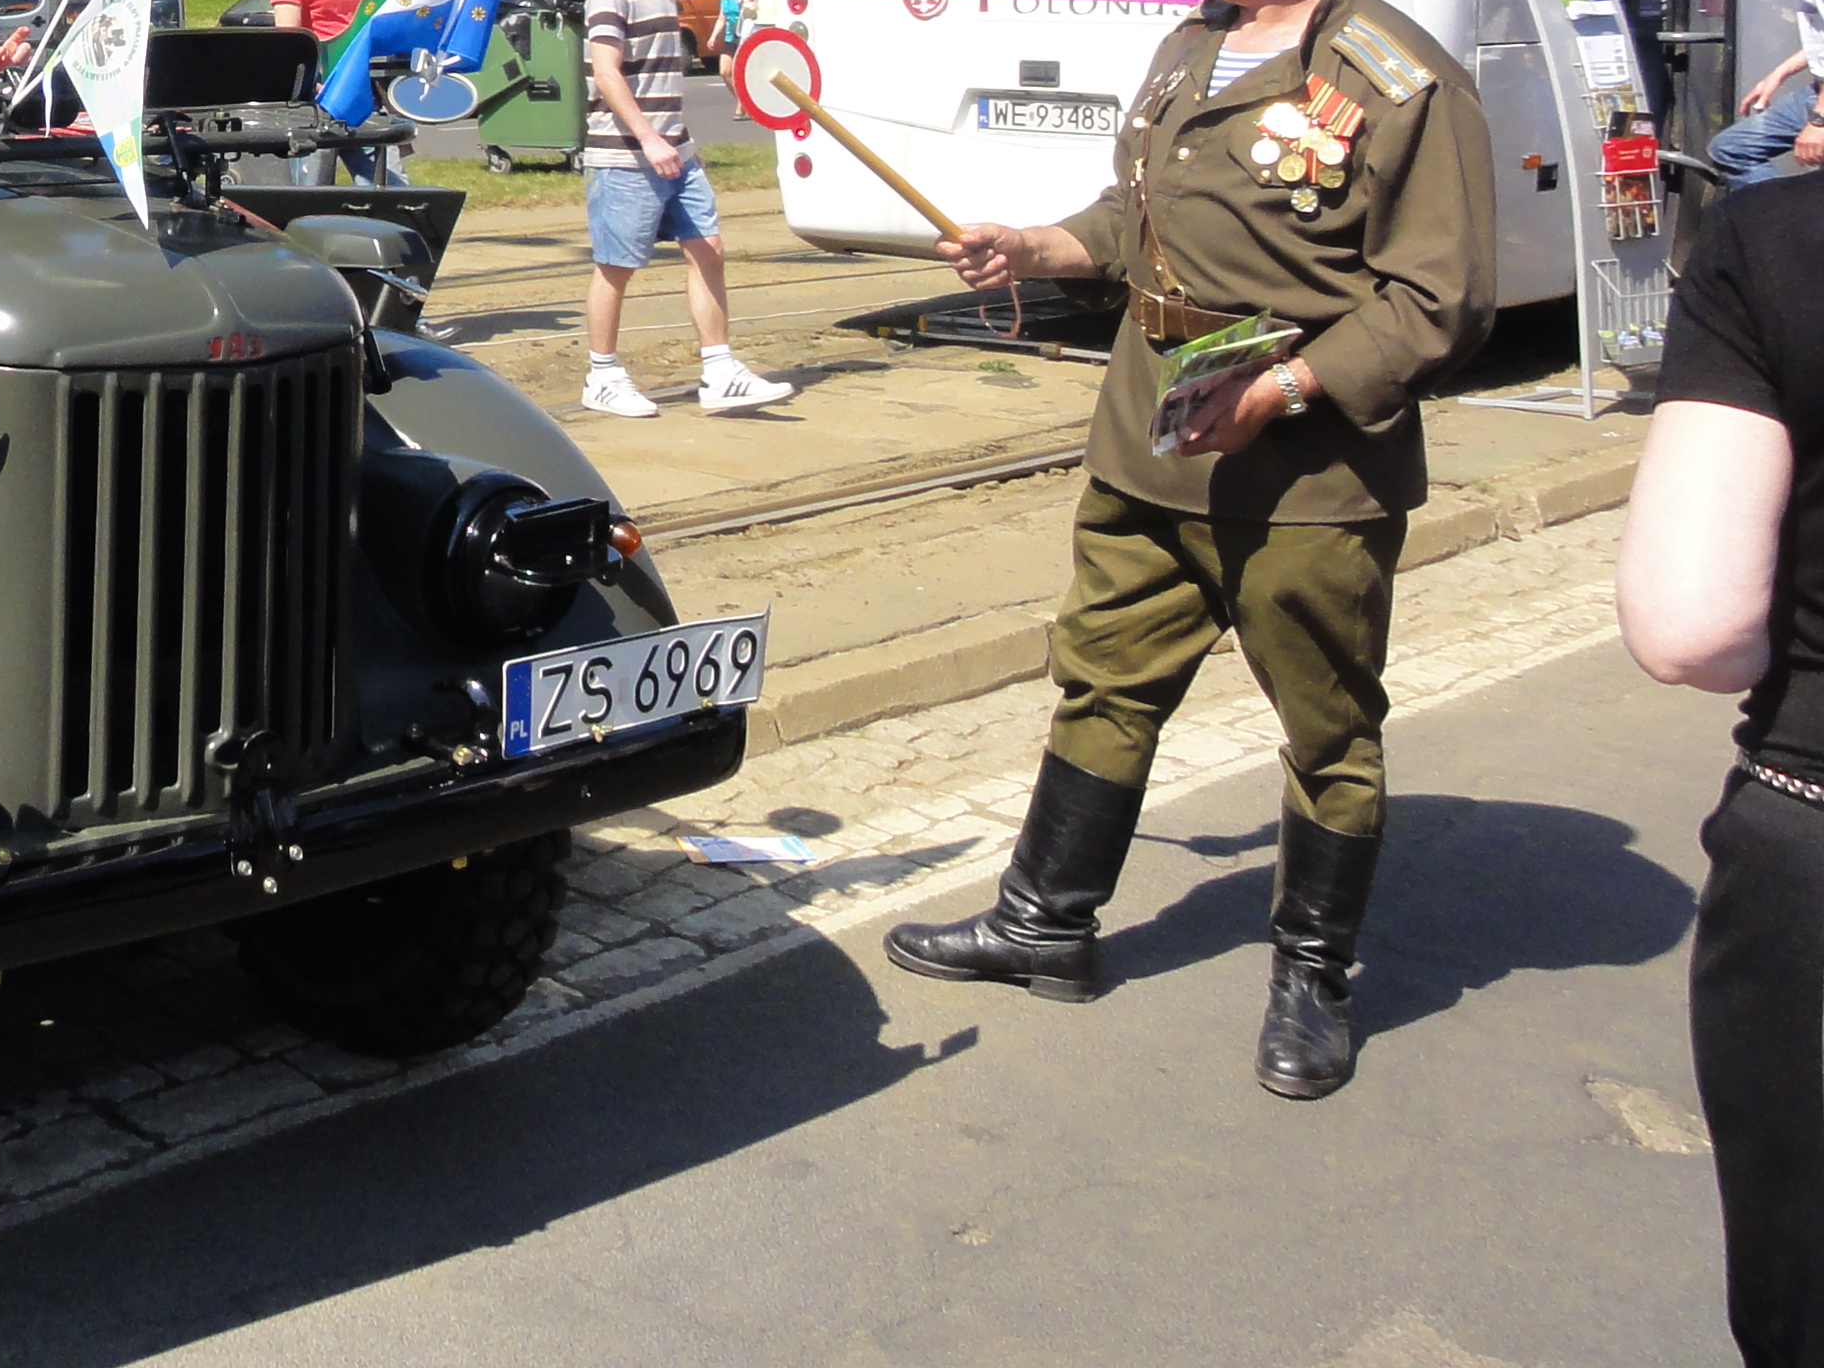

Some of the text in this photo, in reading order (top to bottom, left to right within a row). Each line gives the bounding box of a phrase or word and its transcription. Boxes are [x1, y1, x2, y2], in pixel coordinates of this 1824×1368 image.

[994, 102, 1111, 131] WE 9348S
[539, 627, 758, 738] ZS 6969
[510, 720, 529, 740] PL
